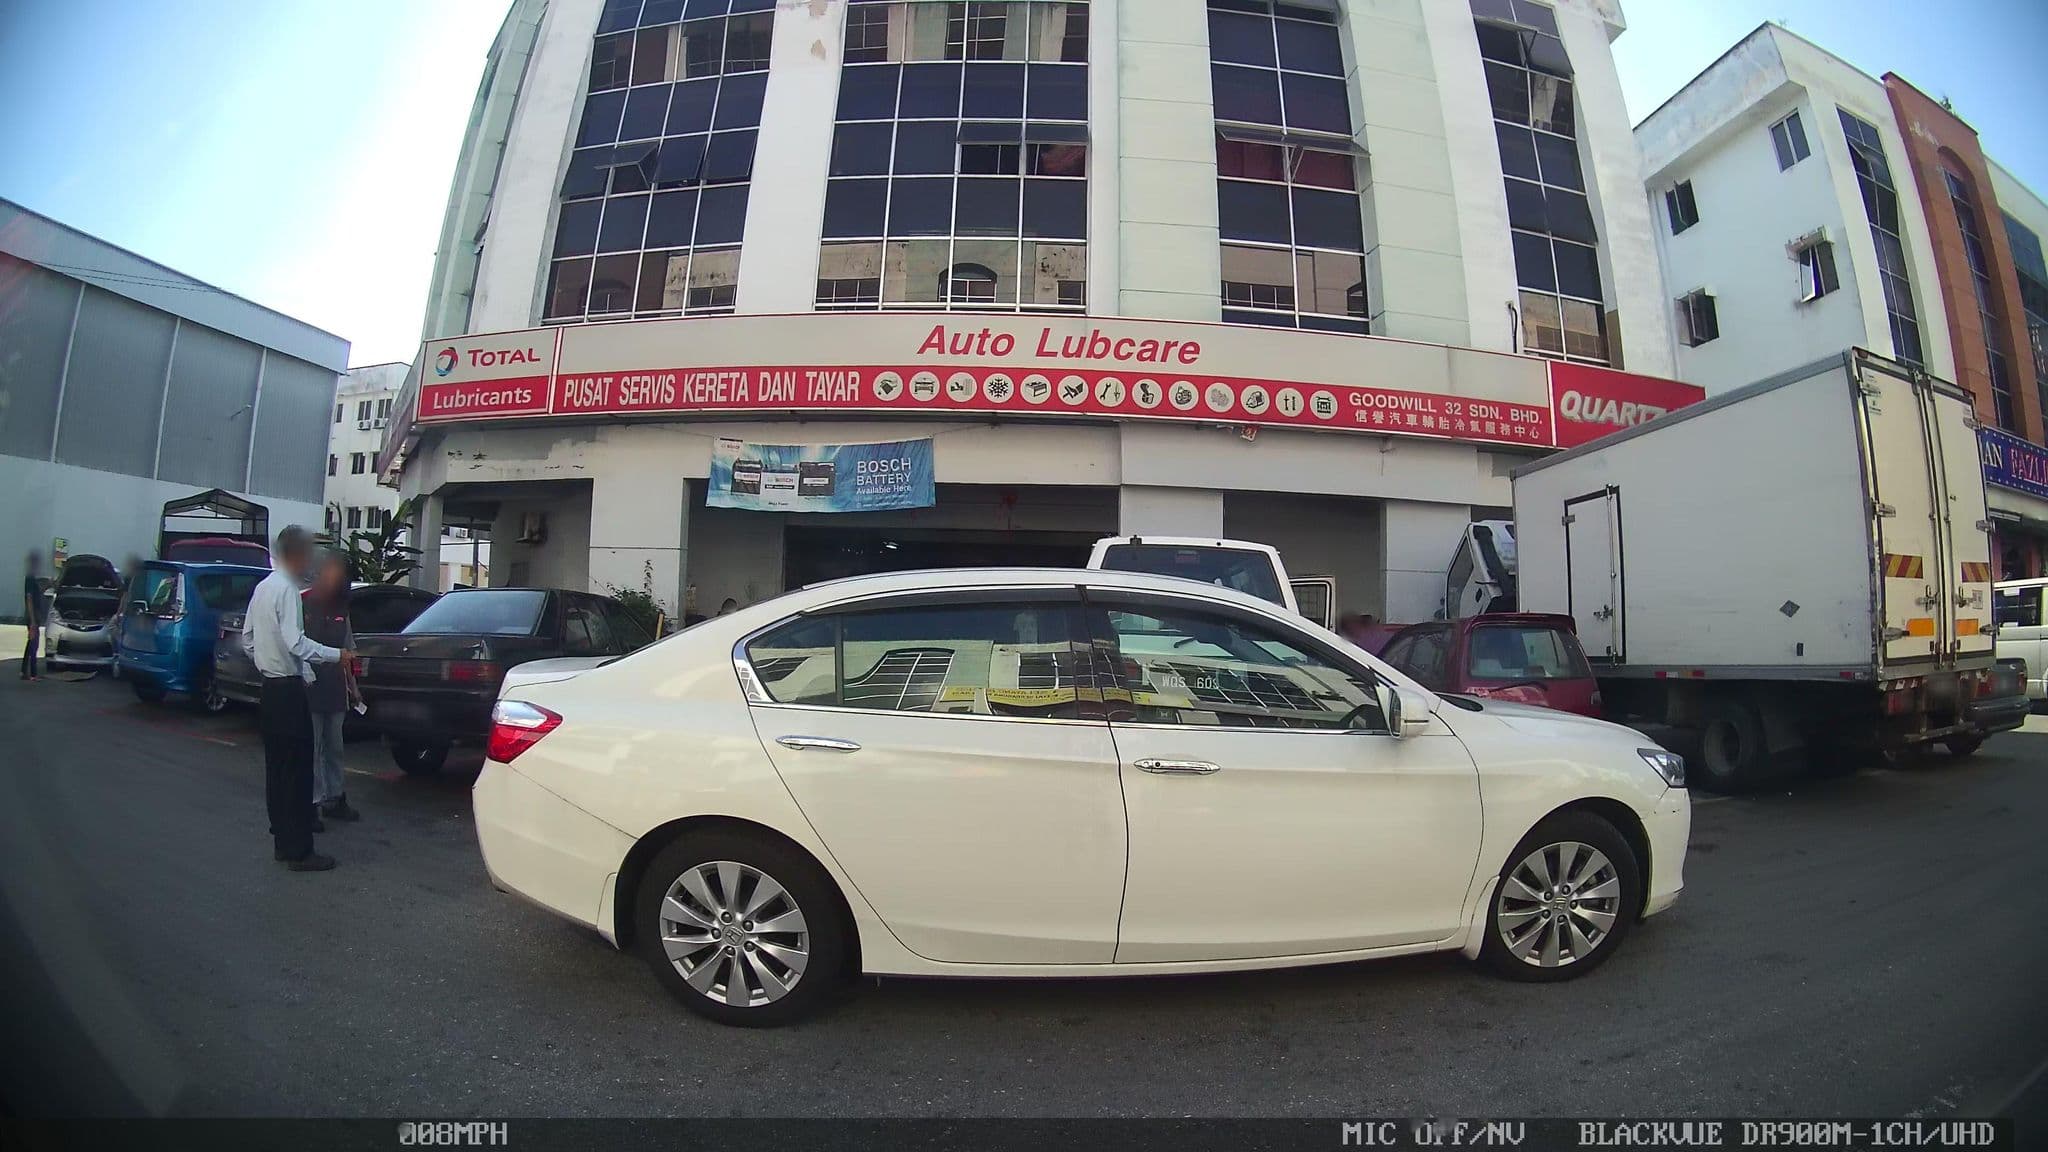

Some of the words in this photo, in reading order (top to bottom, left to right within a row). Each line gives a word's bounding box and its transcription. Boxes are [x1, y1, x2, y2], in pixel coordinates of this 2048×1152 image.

[916, 325, 1015, 357] Auto
[1035, 327, 1201, 364] Lubcare
[433, 387, 532, 410] Lubricants
[563, 377, 613, 407] PUSAT
[619, 374, 676, 406] SERVIS
[683, 371, 749, 403] KERETA
[758, 371, 796, 402] DAN
[805, 371, 860, 402] TAYAR
[1349, 392, 1437, 413] GOODWILL
[1445, 402, 1462, 415] 32
[1469, 404, 1503, 420] SDN.
[1510, 408, 1543, 424] BHD.
[857, 457, 911, 473] BOSCH
[856, 472, 911, 486] BATTERY
[856, 486, 891, 495] Available
